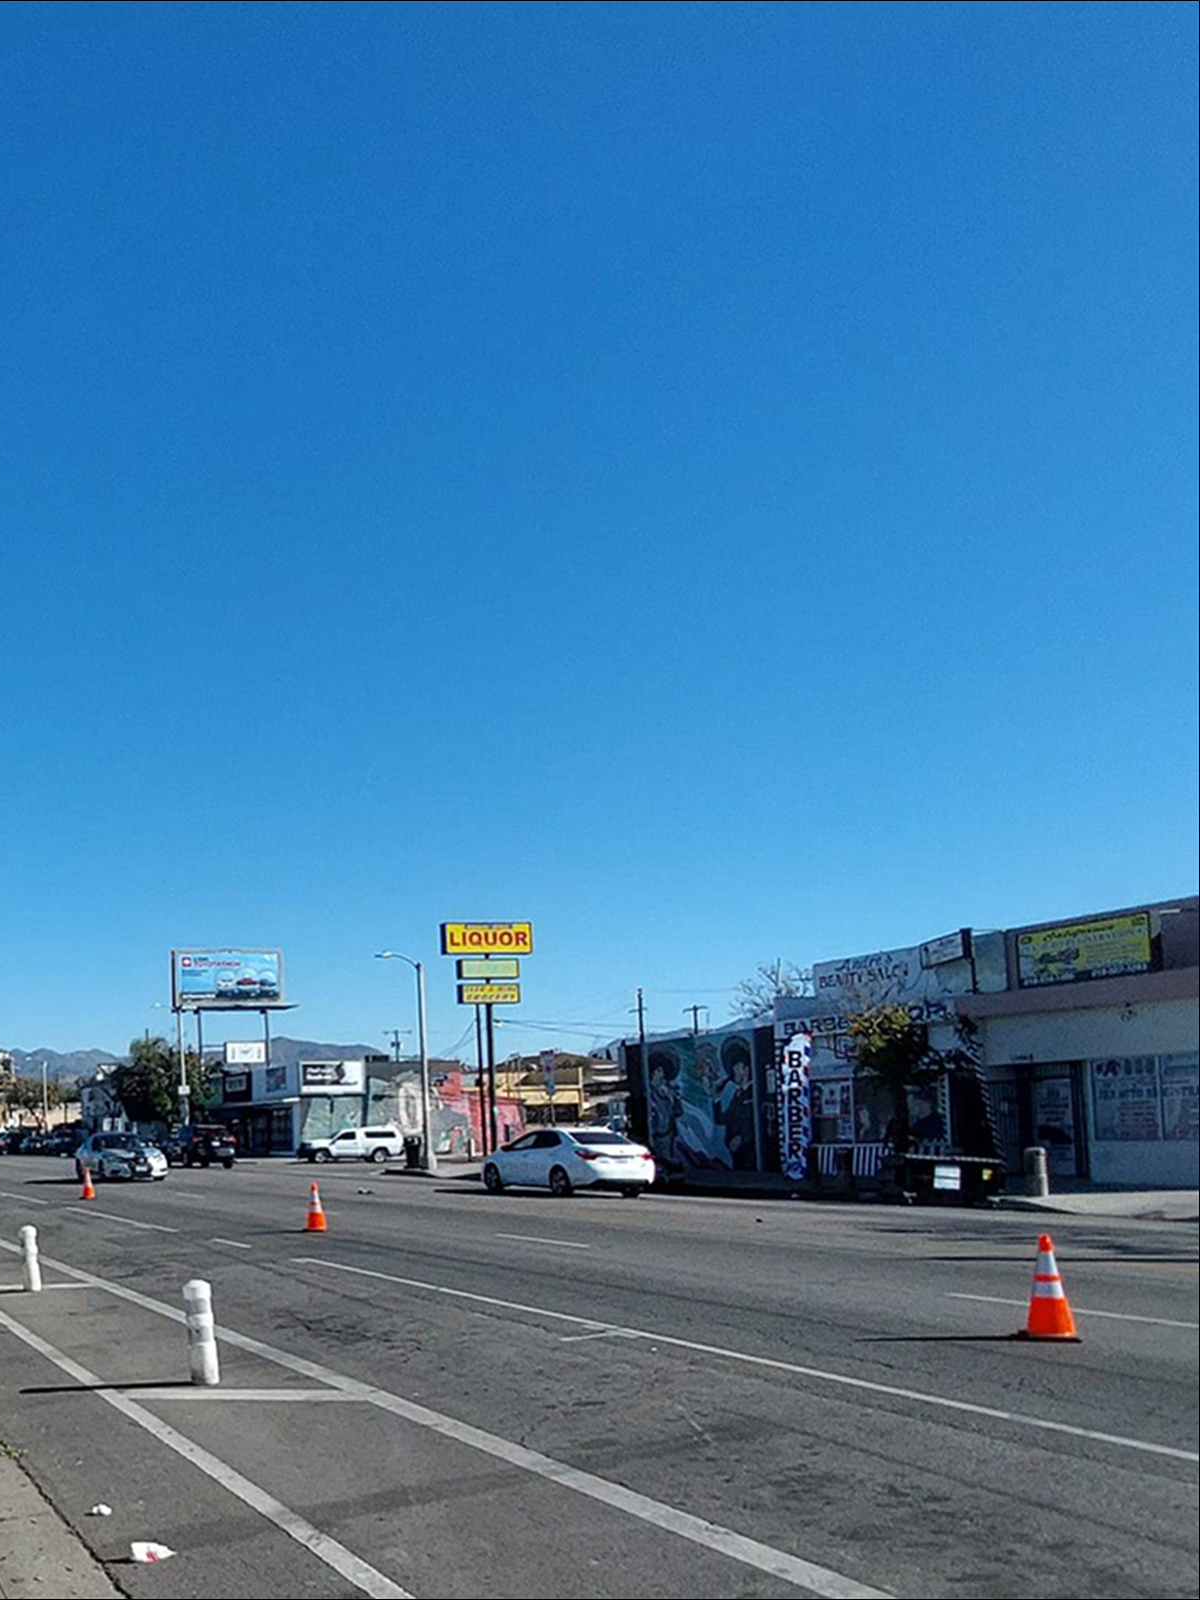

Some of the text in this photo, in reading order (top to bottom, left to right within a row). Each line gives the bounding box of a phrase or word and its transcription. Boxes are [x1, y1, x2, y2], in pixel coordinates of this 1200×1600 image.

[449, 931, 528, 947] LIQUOR
[818, 970, 863, 989] BEAUTY
[783, 1014, 858, 1036] BARBE
[788, 1051, 803, 1159] BARBER
